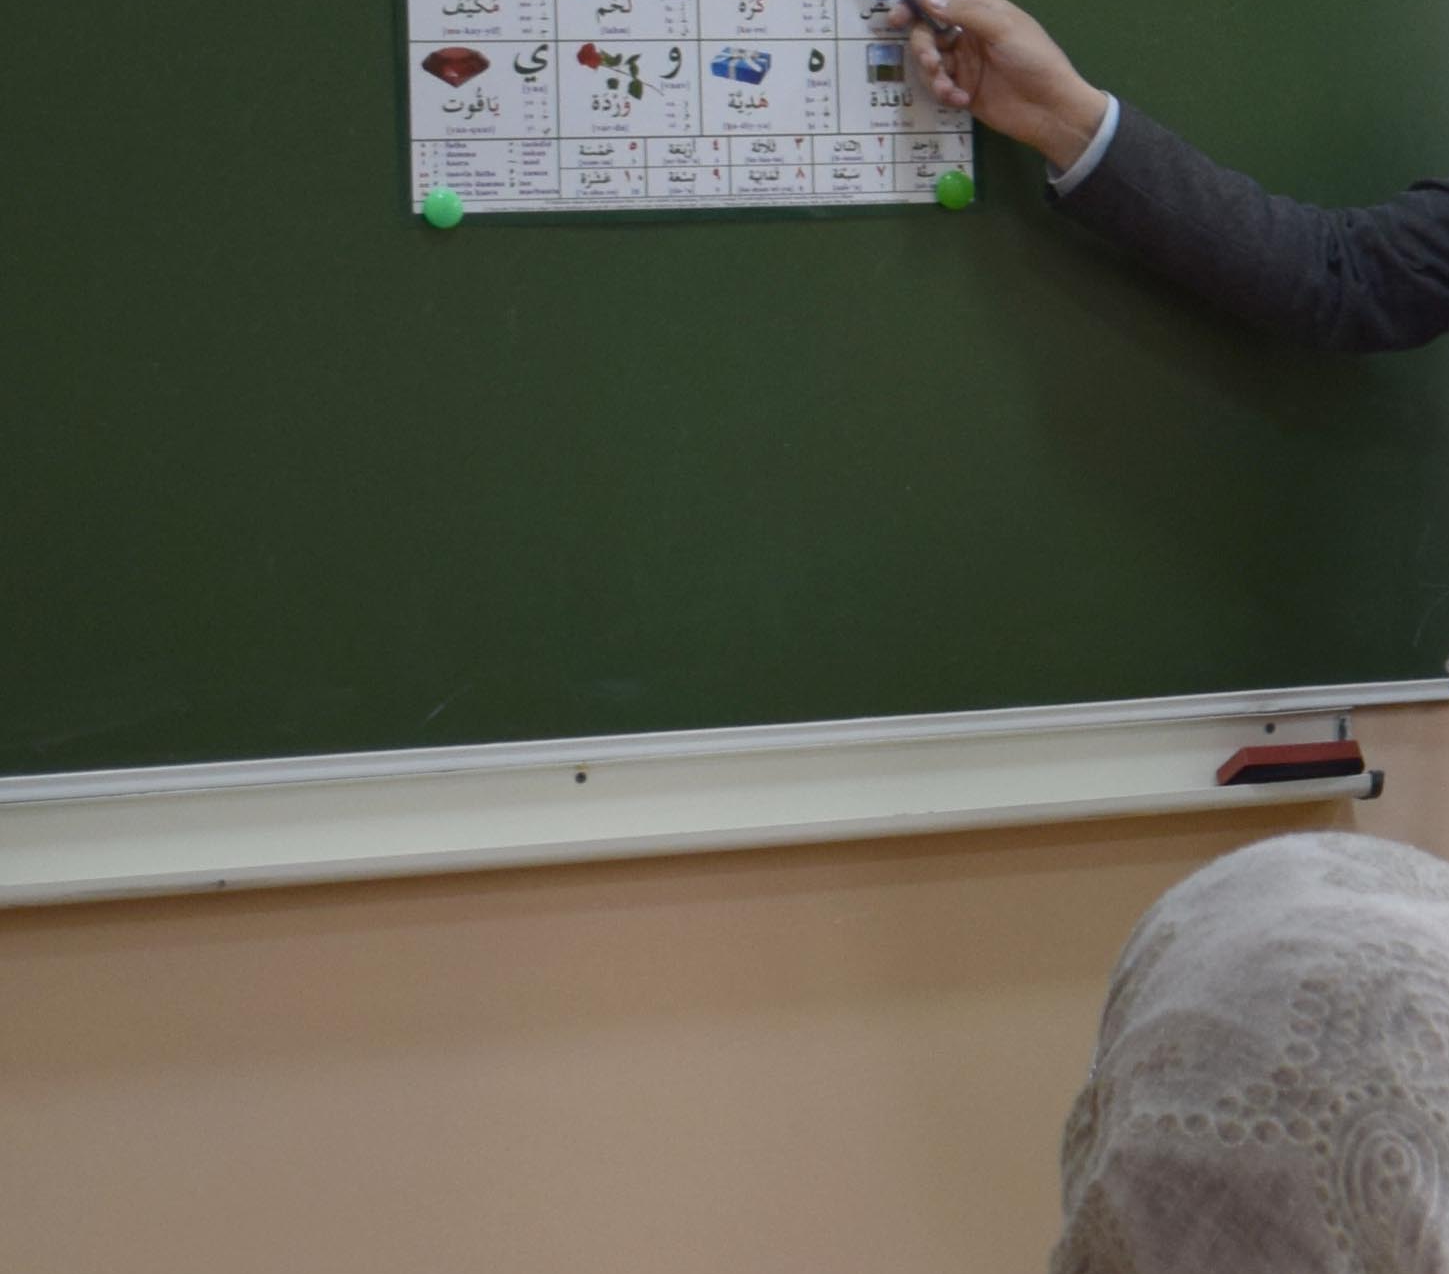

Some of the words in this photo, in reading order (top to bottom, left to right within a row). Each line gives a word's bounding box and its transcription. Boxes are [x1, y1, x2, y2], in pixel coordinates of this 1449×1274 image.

[513, 43, 549, 83] ي
[659, 46, 682, 79] و
[808, 47, 825, 73] ه
